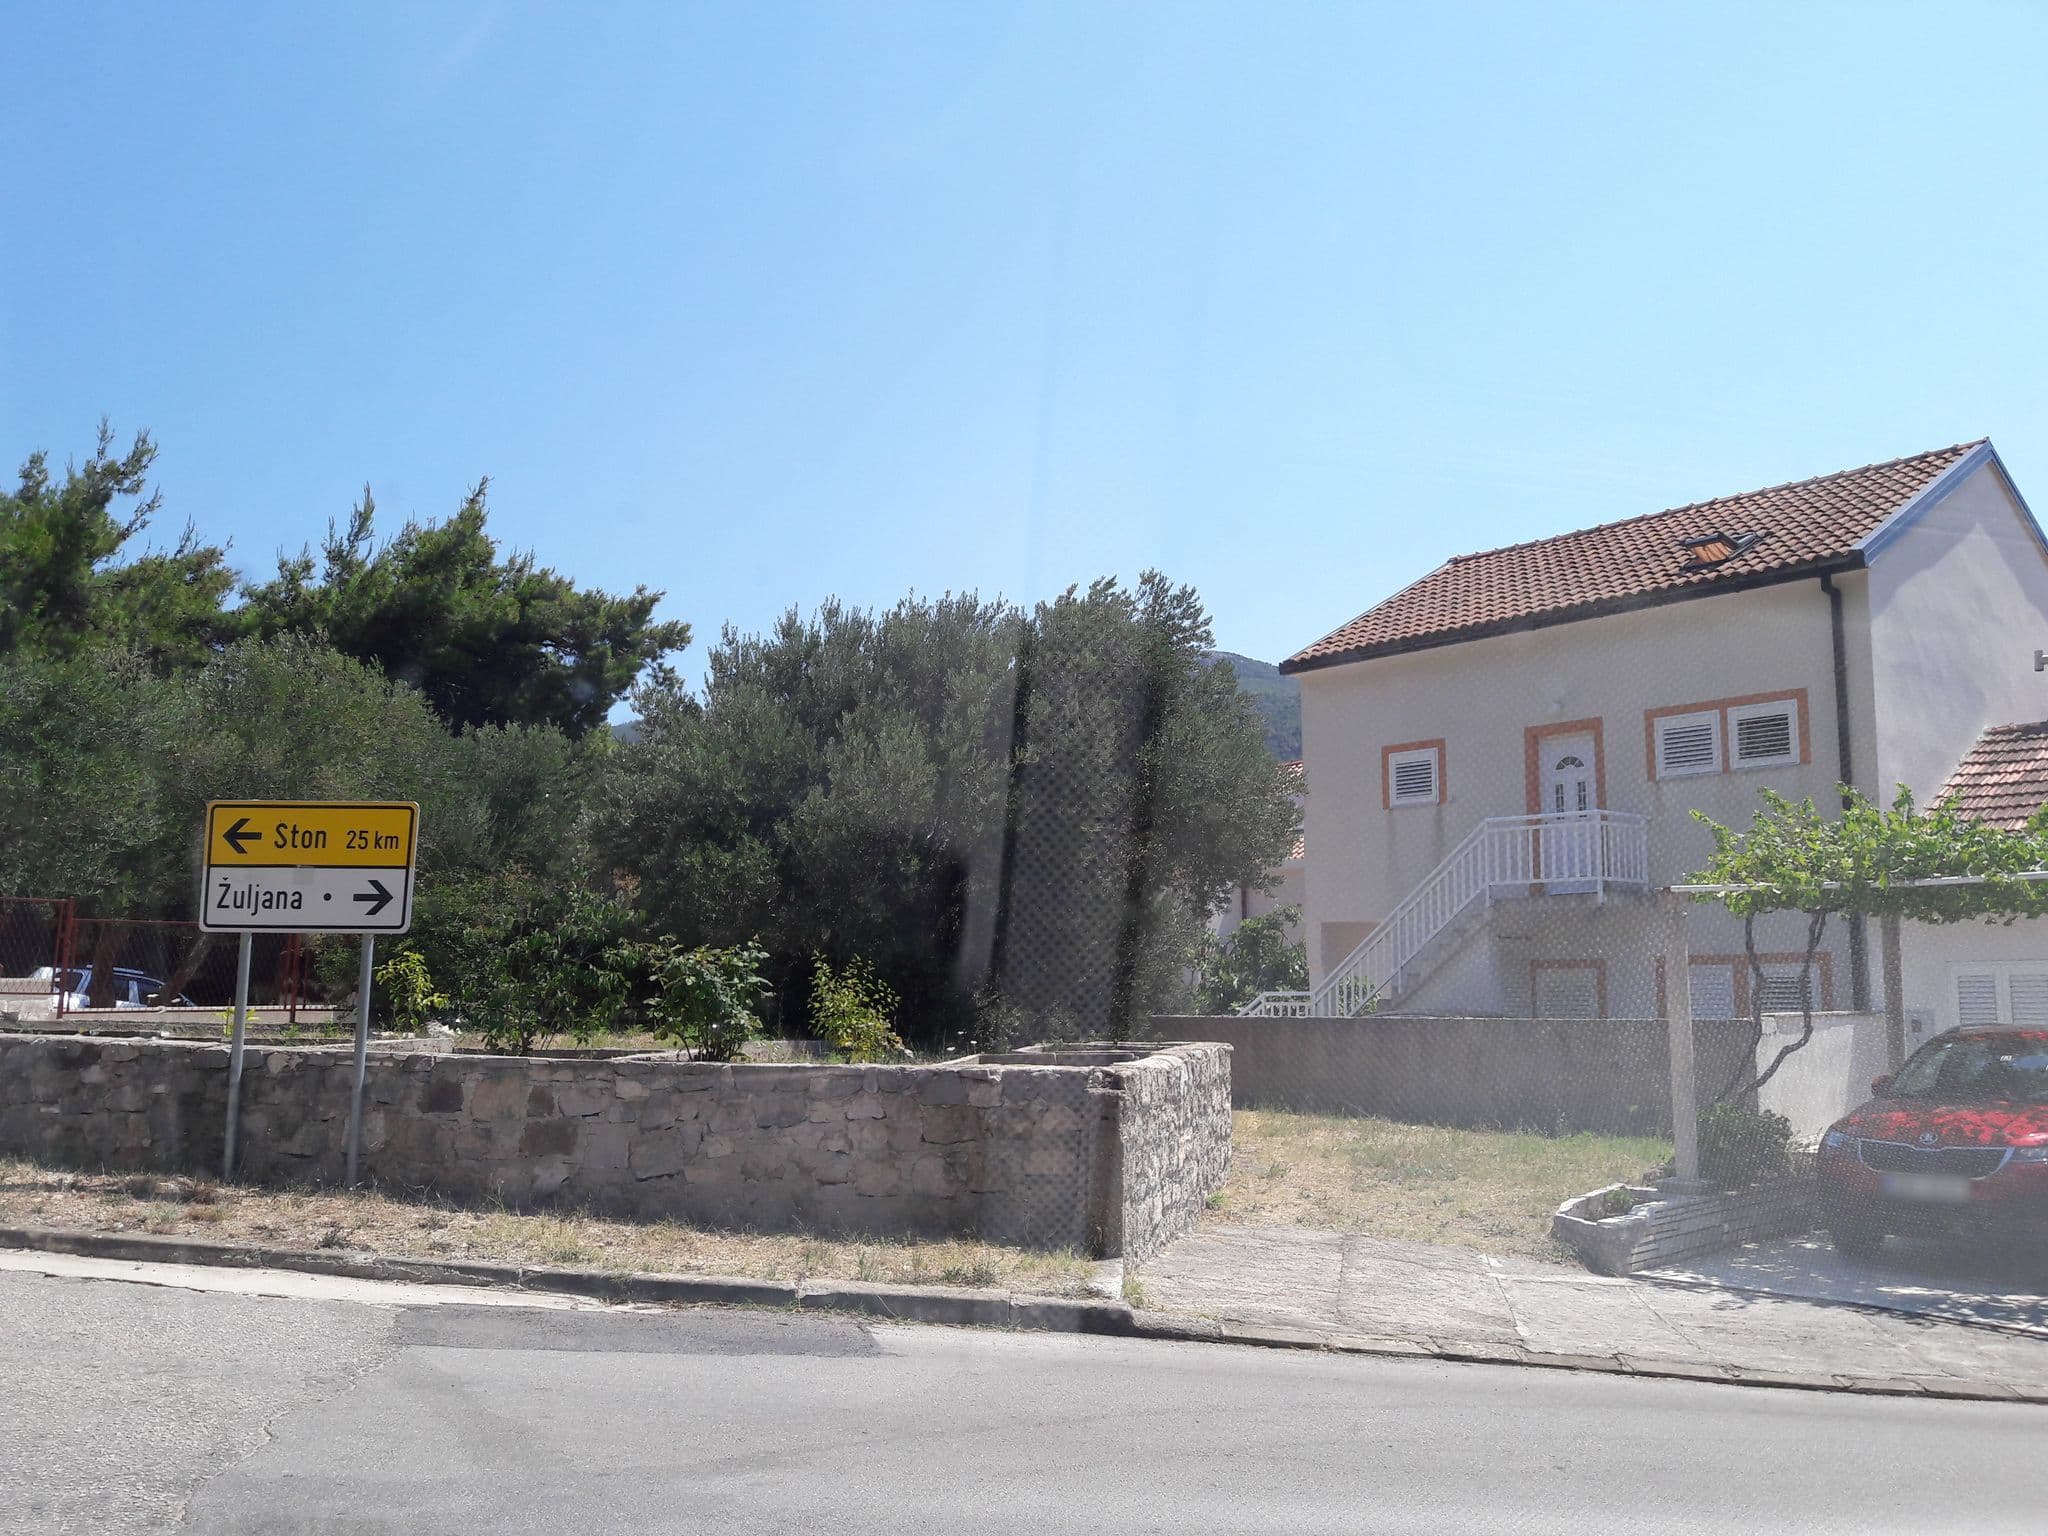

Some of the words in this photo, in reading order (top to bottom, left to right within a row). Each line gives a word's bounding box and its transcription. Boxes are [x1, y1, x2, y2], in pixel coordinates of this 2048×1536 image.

[274, 822, 327, 849] Ston
[346, 830, 369, 850] 25
[374, 831, 399, 850] km
[216, 877, 303, 916] Žuljana
